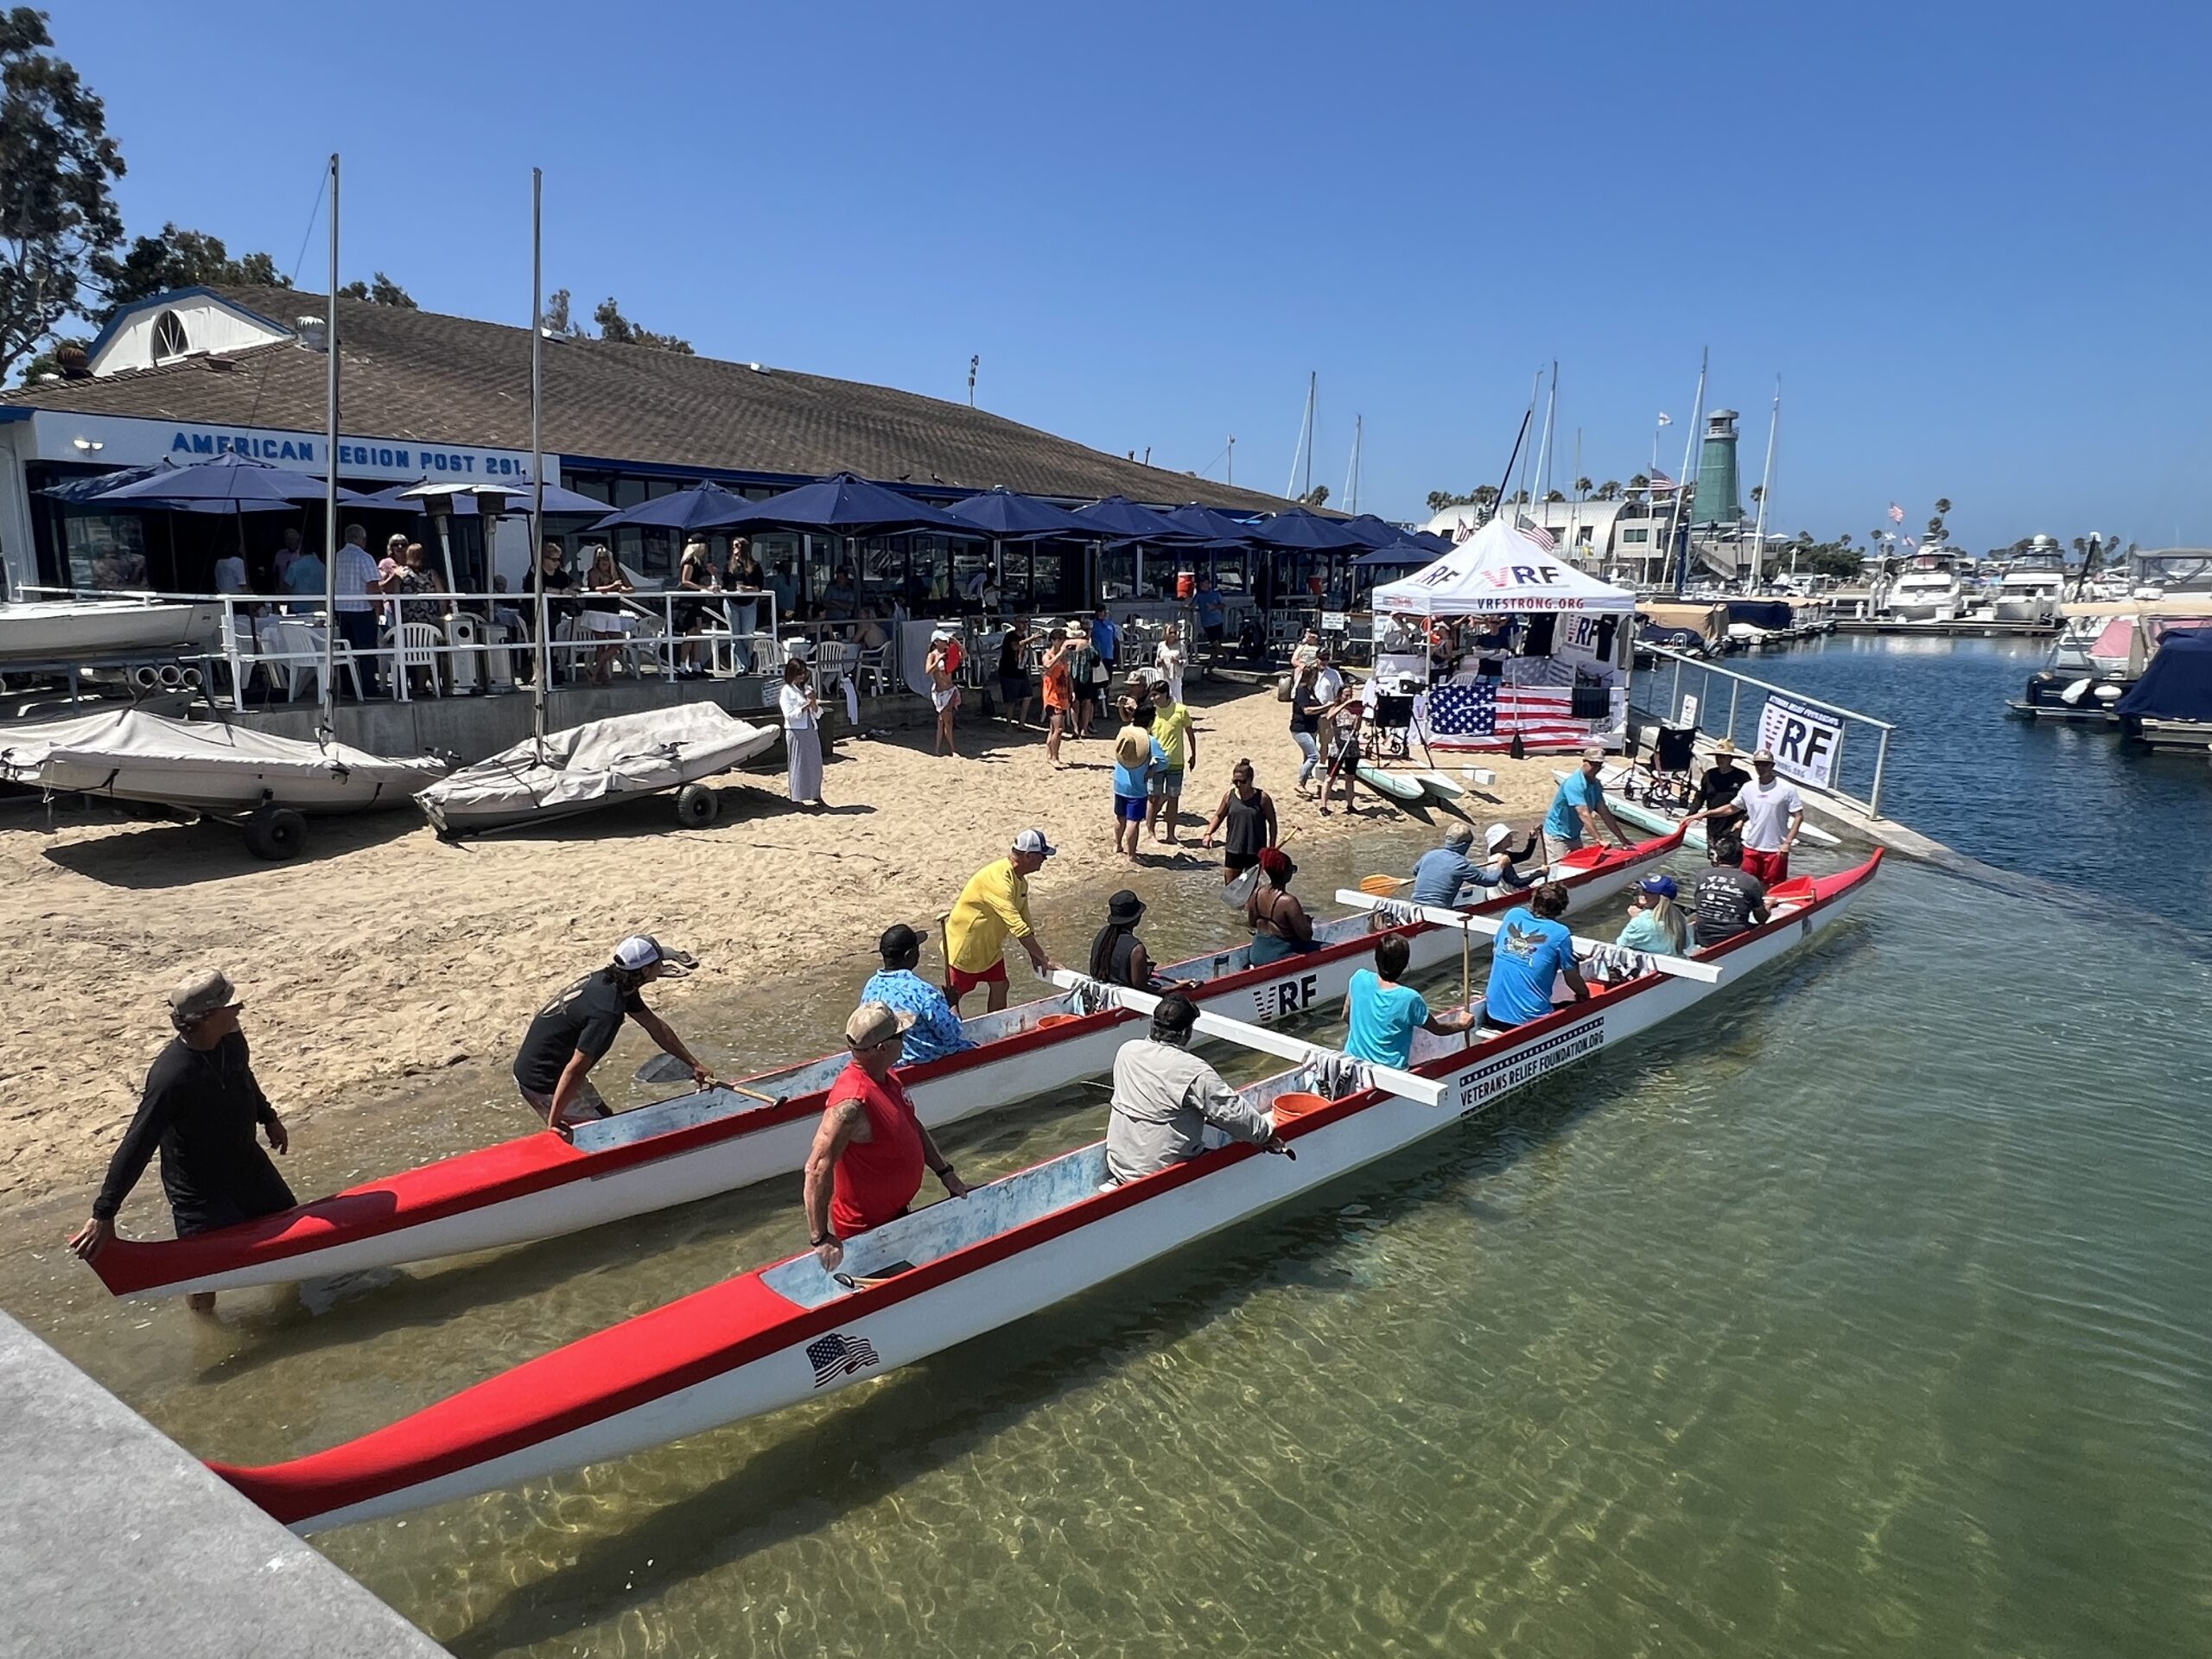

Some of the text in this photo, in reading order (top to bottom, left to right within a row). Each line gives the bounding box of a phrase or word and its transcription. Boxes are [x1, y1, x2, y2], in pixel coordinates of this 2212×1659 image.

[172, 432, 314, 461] AMERICAN
[326, 443, 410, 468] EGION
[420, 452, 474, 473] POST
[1482, 566, 1560, 588] VRF
[1477, 598, 1585, 610] VRFSTRONG.ORG
[1764, 708, 1833, 768] VRF
[1253, 974, 1318, 1021] VRF
[1460, 1030, 1605, 1107] VETERANS RELIEF FOUNDATION.ORG
